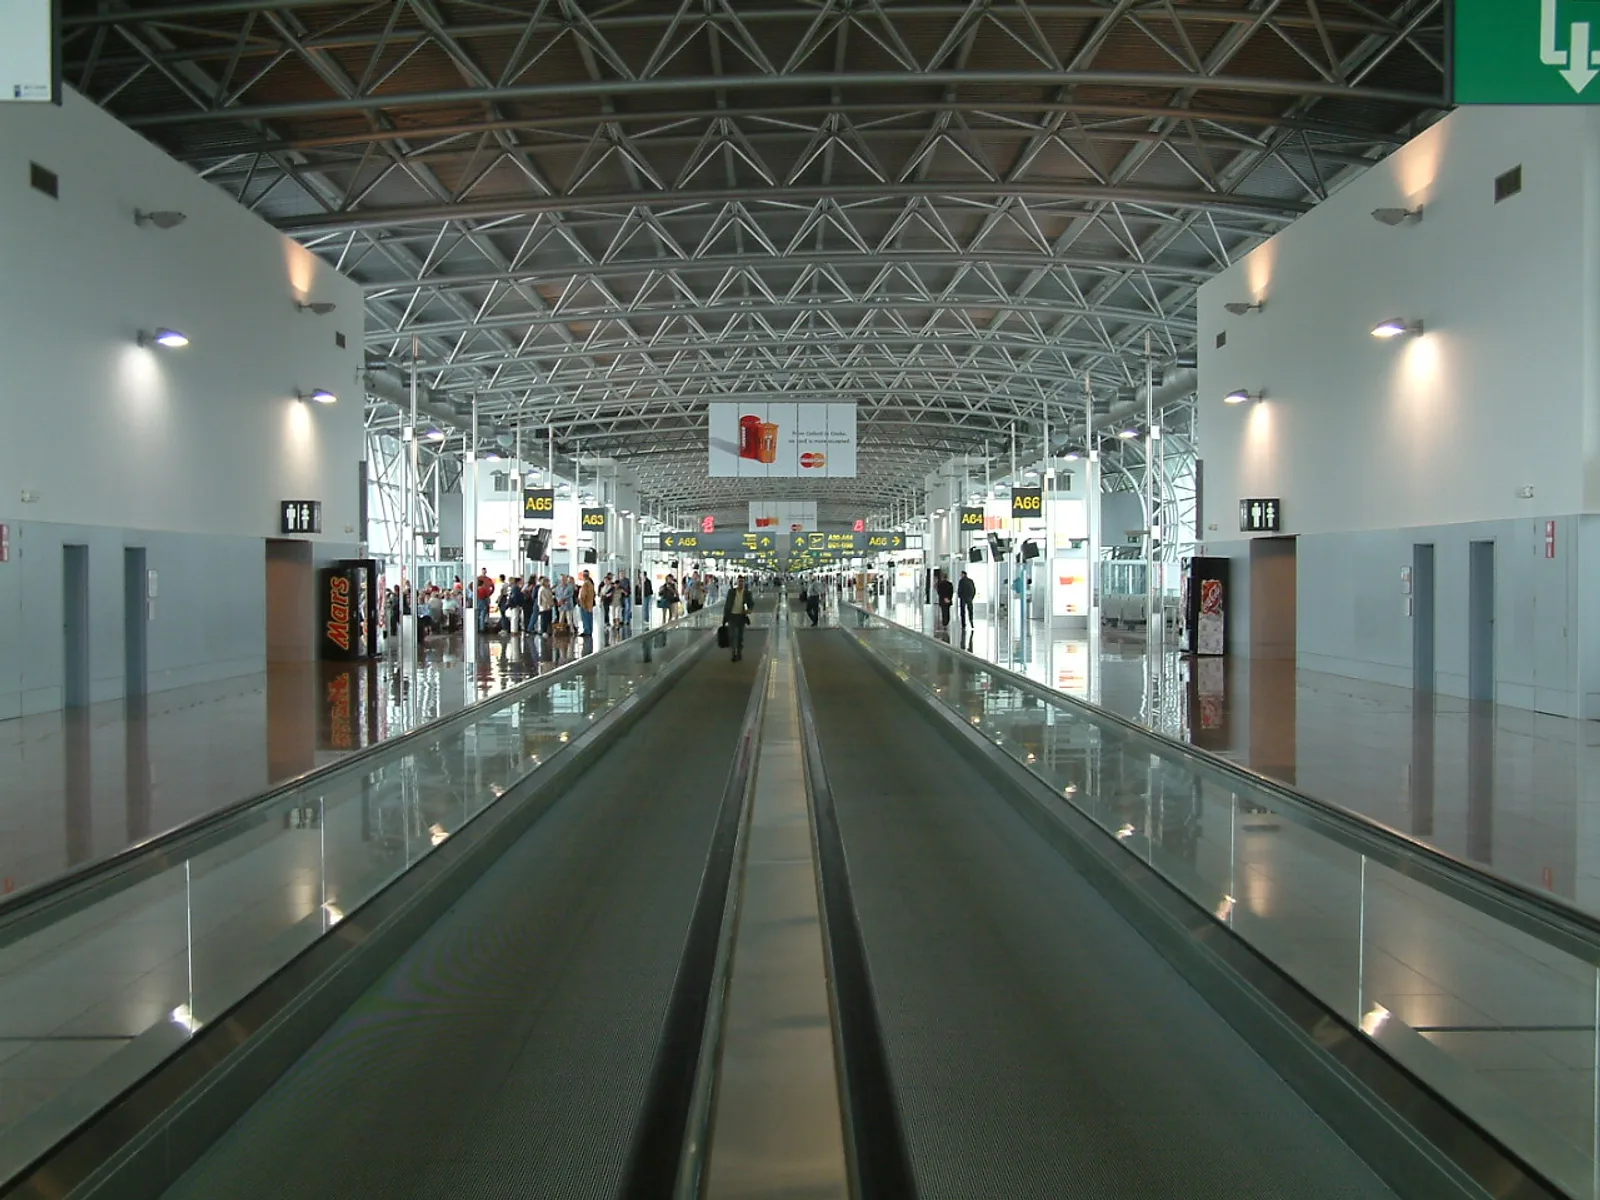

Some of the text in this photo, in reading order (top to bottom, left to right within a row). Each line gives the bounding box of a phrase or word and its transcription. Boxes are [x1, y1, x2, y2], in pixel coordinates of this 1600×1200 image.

[525, 497, 553, 511] A65
[1013, 496, 1040, 509] A66
[582, 514, 604, 525] A63
[961, 513, 983, 524] A64
[326, 575, 349, 650] Mars
